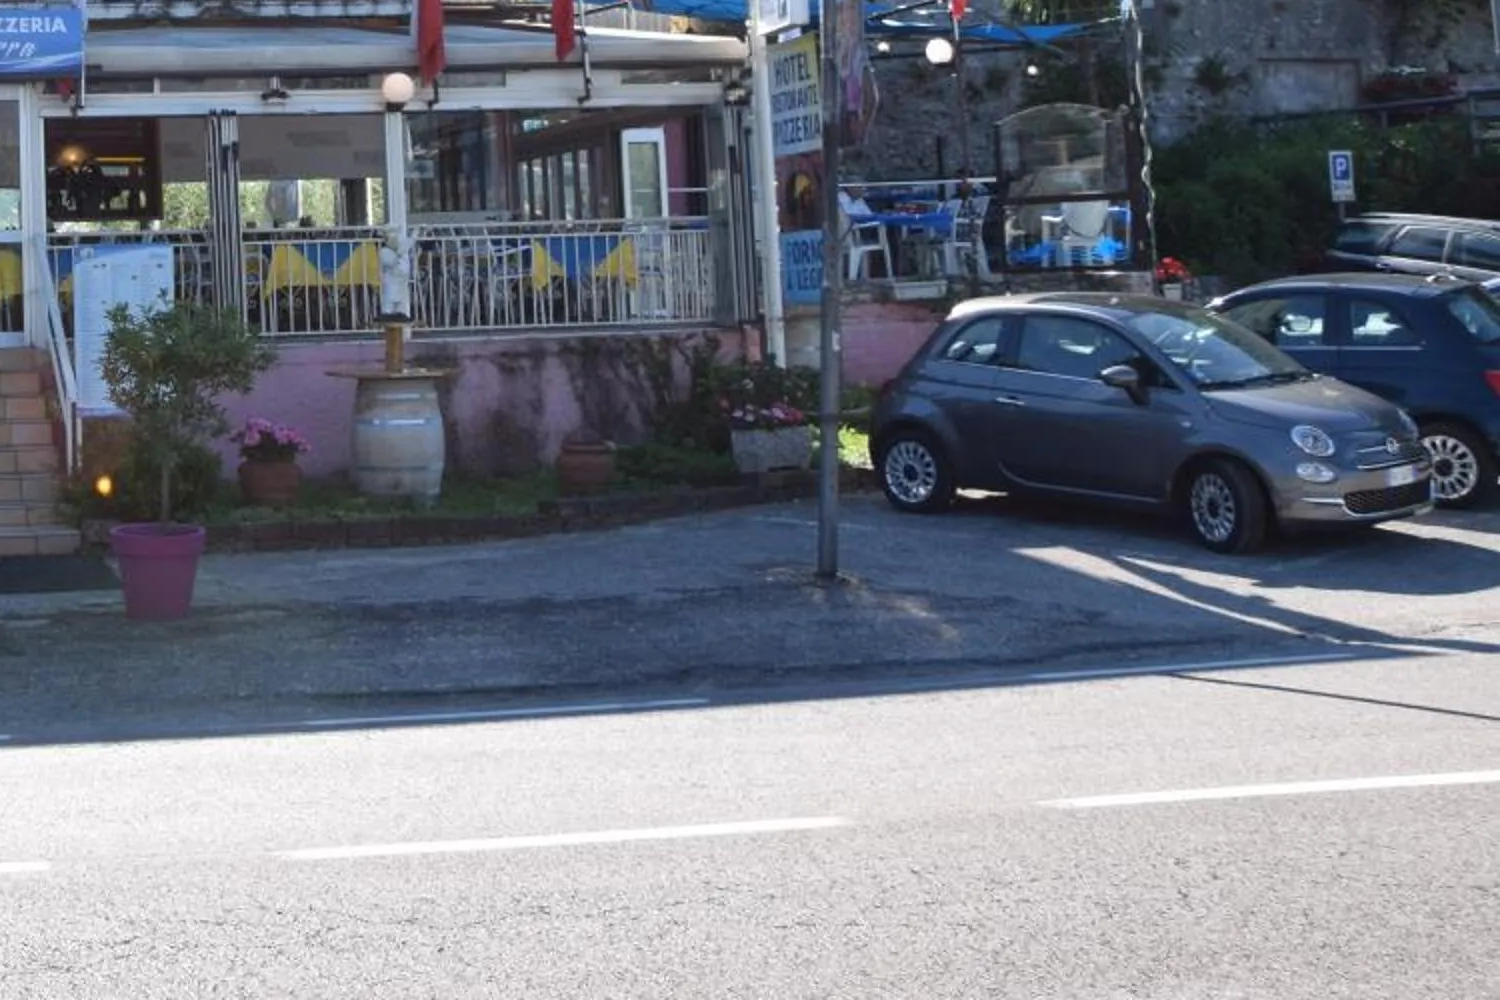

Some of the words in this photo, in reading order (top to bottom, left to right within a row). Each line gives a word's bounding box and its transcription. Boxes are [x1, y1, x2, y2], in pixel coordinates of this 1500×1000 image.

[773, 51, 812, 87] HOTEL
[772, 112, 821, 147] PIZZERIA
[1335, 157, 1347, 177] P
